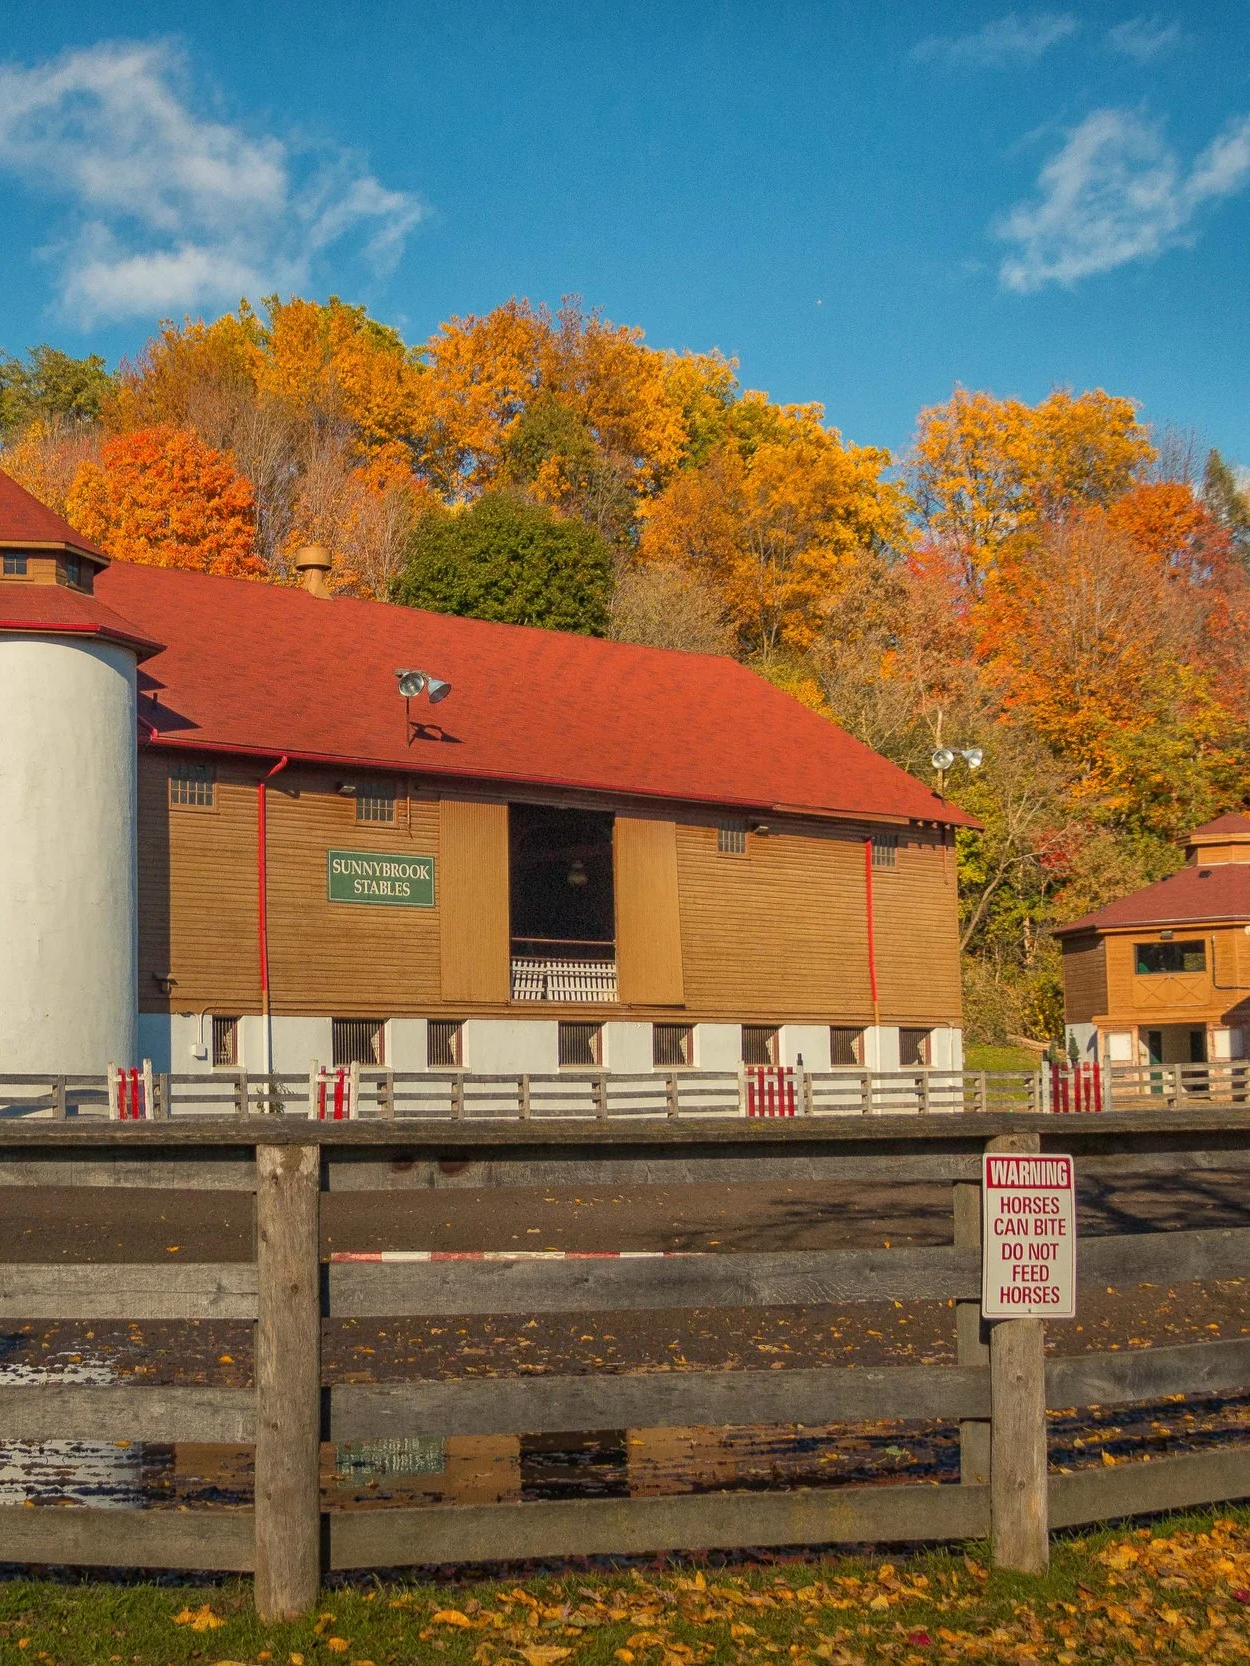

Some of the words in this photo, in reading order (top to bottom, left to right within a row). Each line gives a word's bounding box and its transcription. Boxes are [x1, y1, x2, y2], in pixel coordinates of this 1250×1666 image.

[332, 859, 430, 879] SUNNYBROOK
[354, 879, 410, 896] STABLES
[990, 1160, 1068, 1186] WARNING
[1000, 1196, 1060, 1214] HORSES
[993, 1218, 1028, 1236] CAN
[1034, 1218, 1066, 1236] BITE
[1002, 1243, 1023, 1260] DO
[1028, 1243, 1059, 1260] NOT
[1012, 1264, 1049, 1282] FEED
[1000, 1286, 1060, 1304] HORSES
